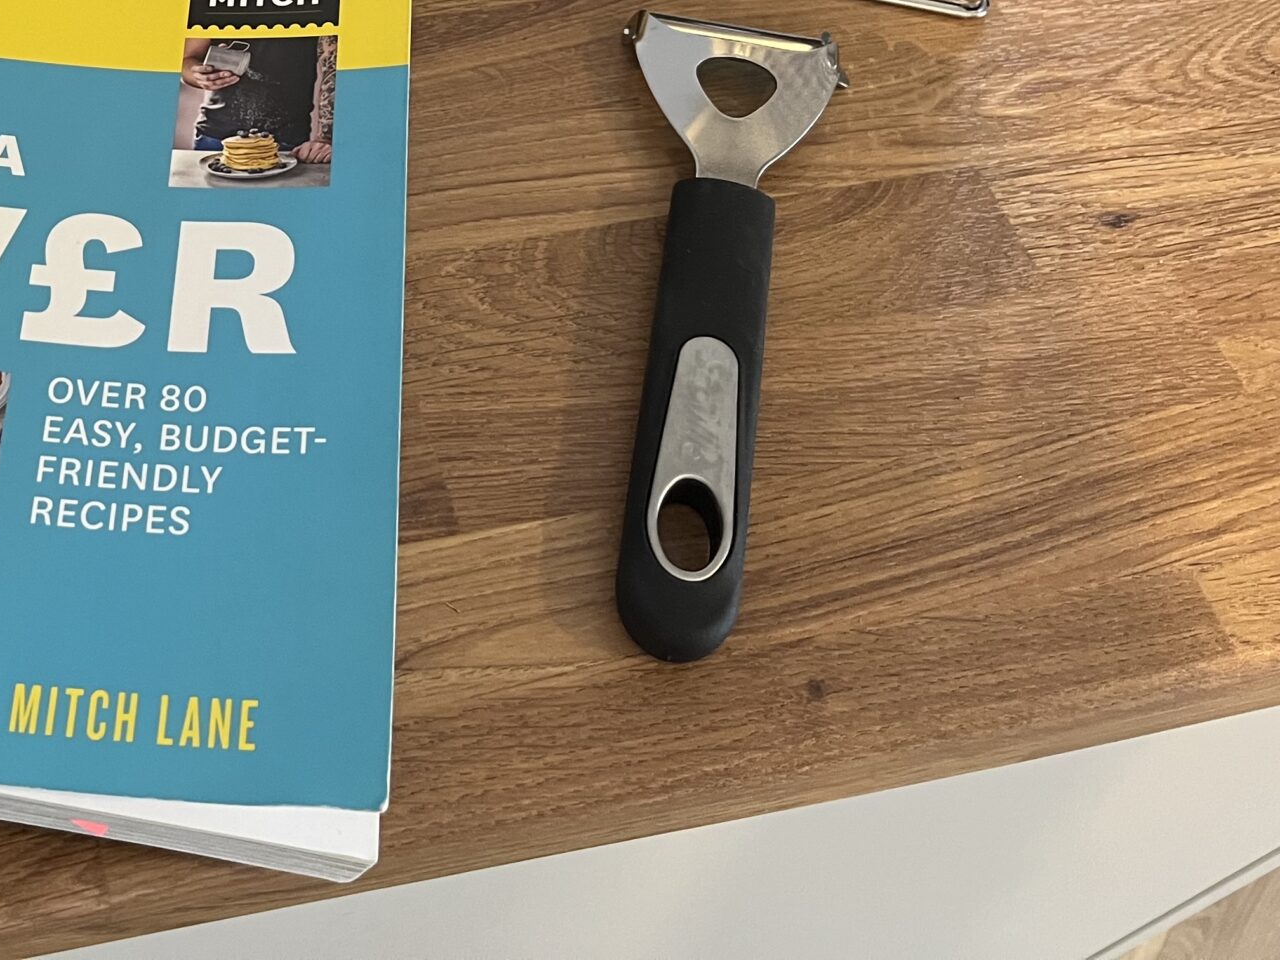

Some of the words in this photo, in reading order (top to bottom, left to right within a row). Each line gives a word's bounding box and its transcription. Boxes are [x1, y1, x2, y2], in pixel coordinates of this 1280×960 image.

[47, 376, 147, 410] OVER
[159, 384, 207, 412] 80
[42, 415, 142, 454] EASY,
[159, 424, 327, 455] BUDGET-
[36, 456, 222, 494] FRIENDLY
[30, 496, 191, 536] RECIPES
[8, 682, 139, 743] MITCH
[156, 694, 259, 752] LANE
